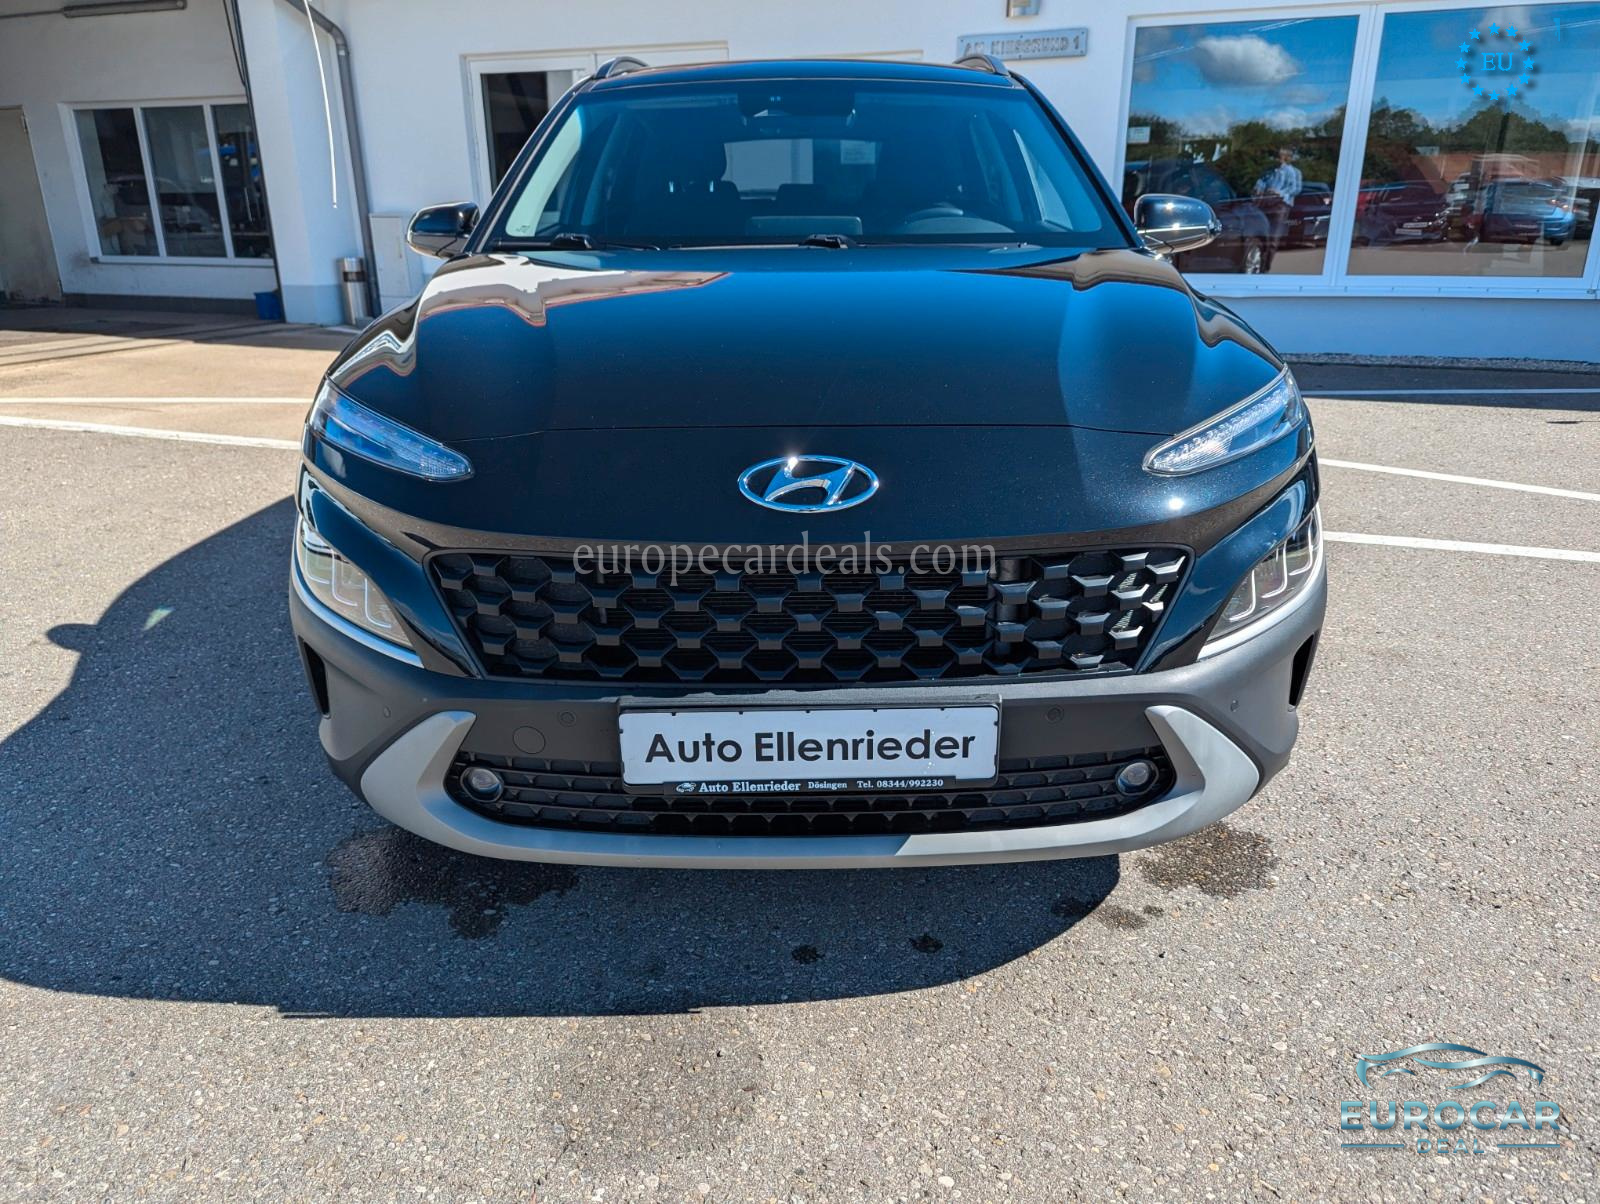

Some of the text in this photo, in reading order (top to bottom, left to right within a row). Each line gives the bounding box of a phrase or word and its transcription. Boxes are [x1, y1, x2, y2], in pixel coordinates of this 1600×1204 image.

[1073, 35, 1080, 50] 1
[645, 729, 976, 763] Auto Ellenrieder
[698, 778, 944, 793] Auto Ellenrieder Dösingen Tel. 08344/992230
